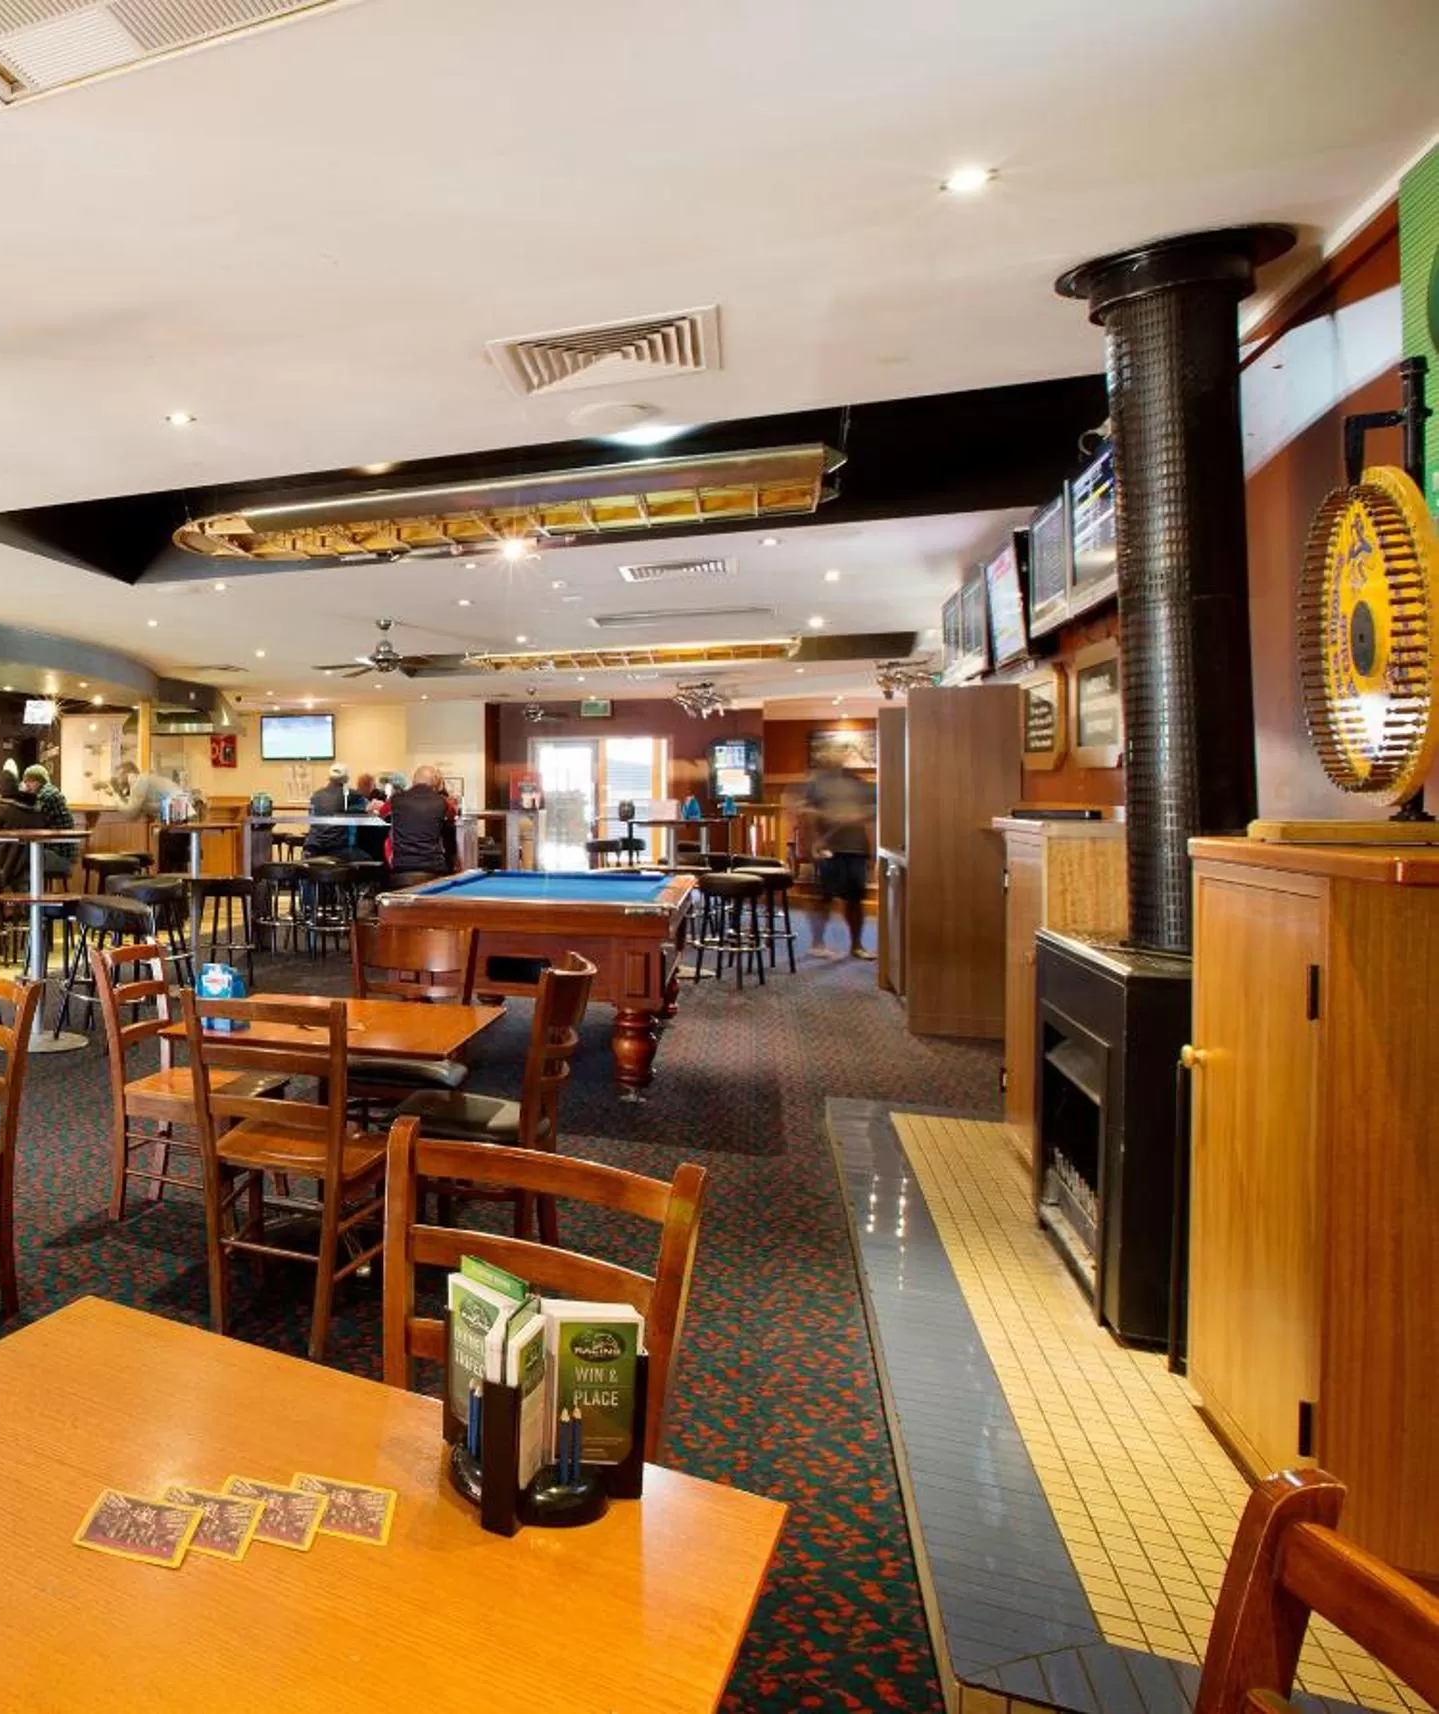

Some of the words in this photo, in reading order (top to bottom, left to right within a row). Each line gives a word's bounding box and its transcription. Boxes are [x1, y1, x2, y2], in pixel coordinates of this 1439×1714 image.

[574, 1366, 601, 1383] WIN
[608, 1368, 619, 1382] &
[573, 1388, 620, 1406] PLACE
